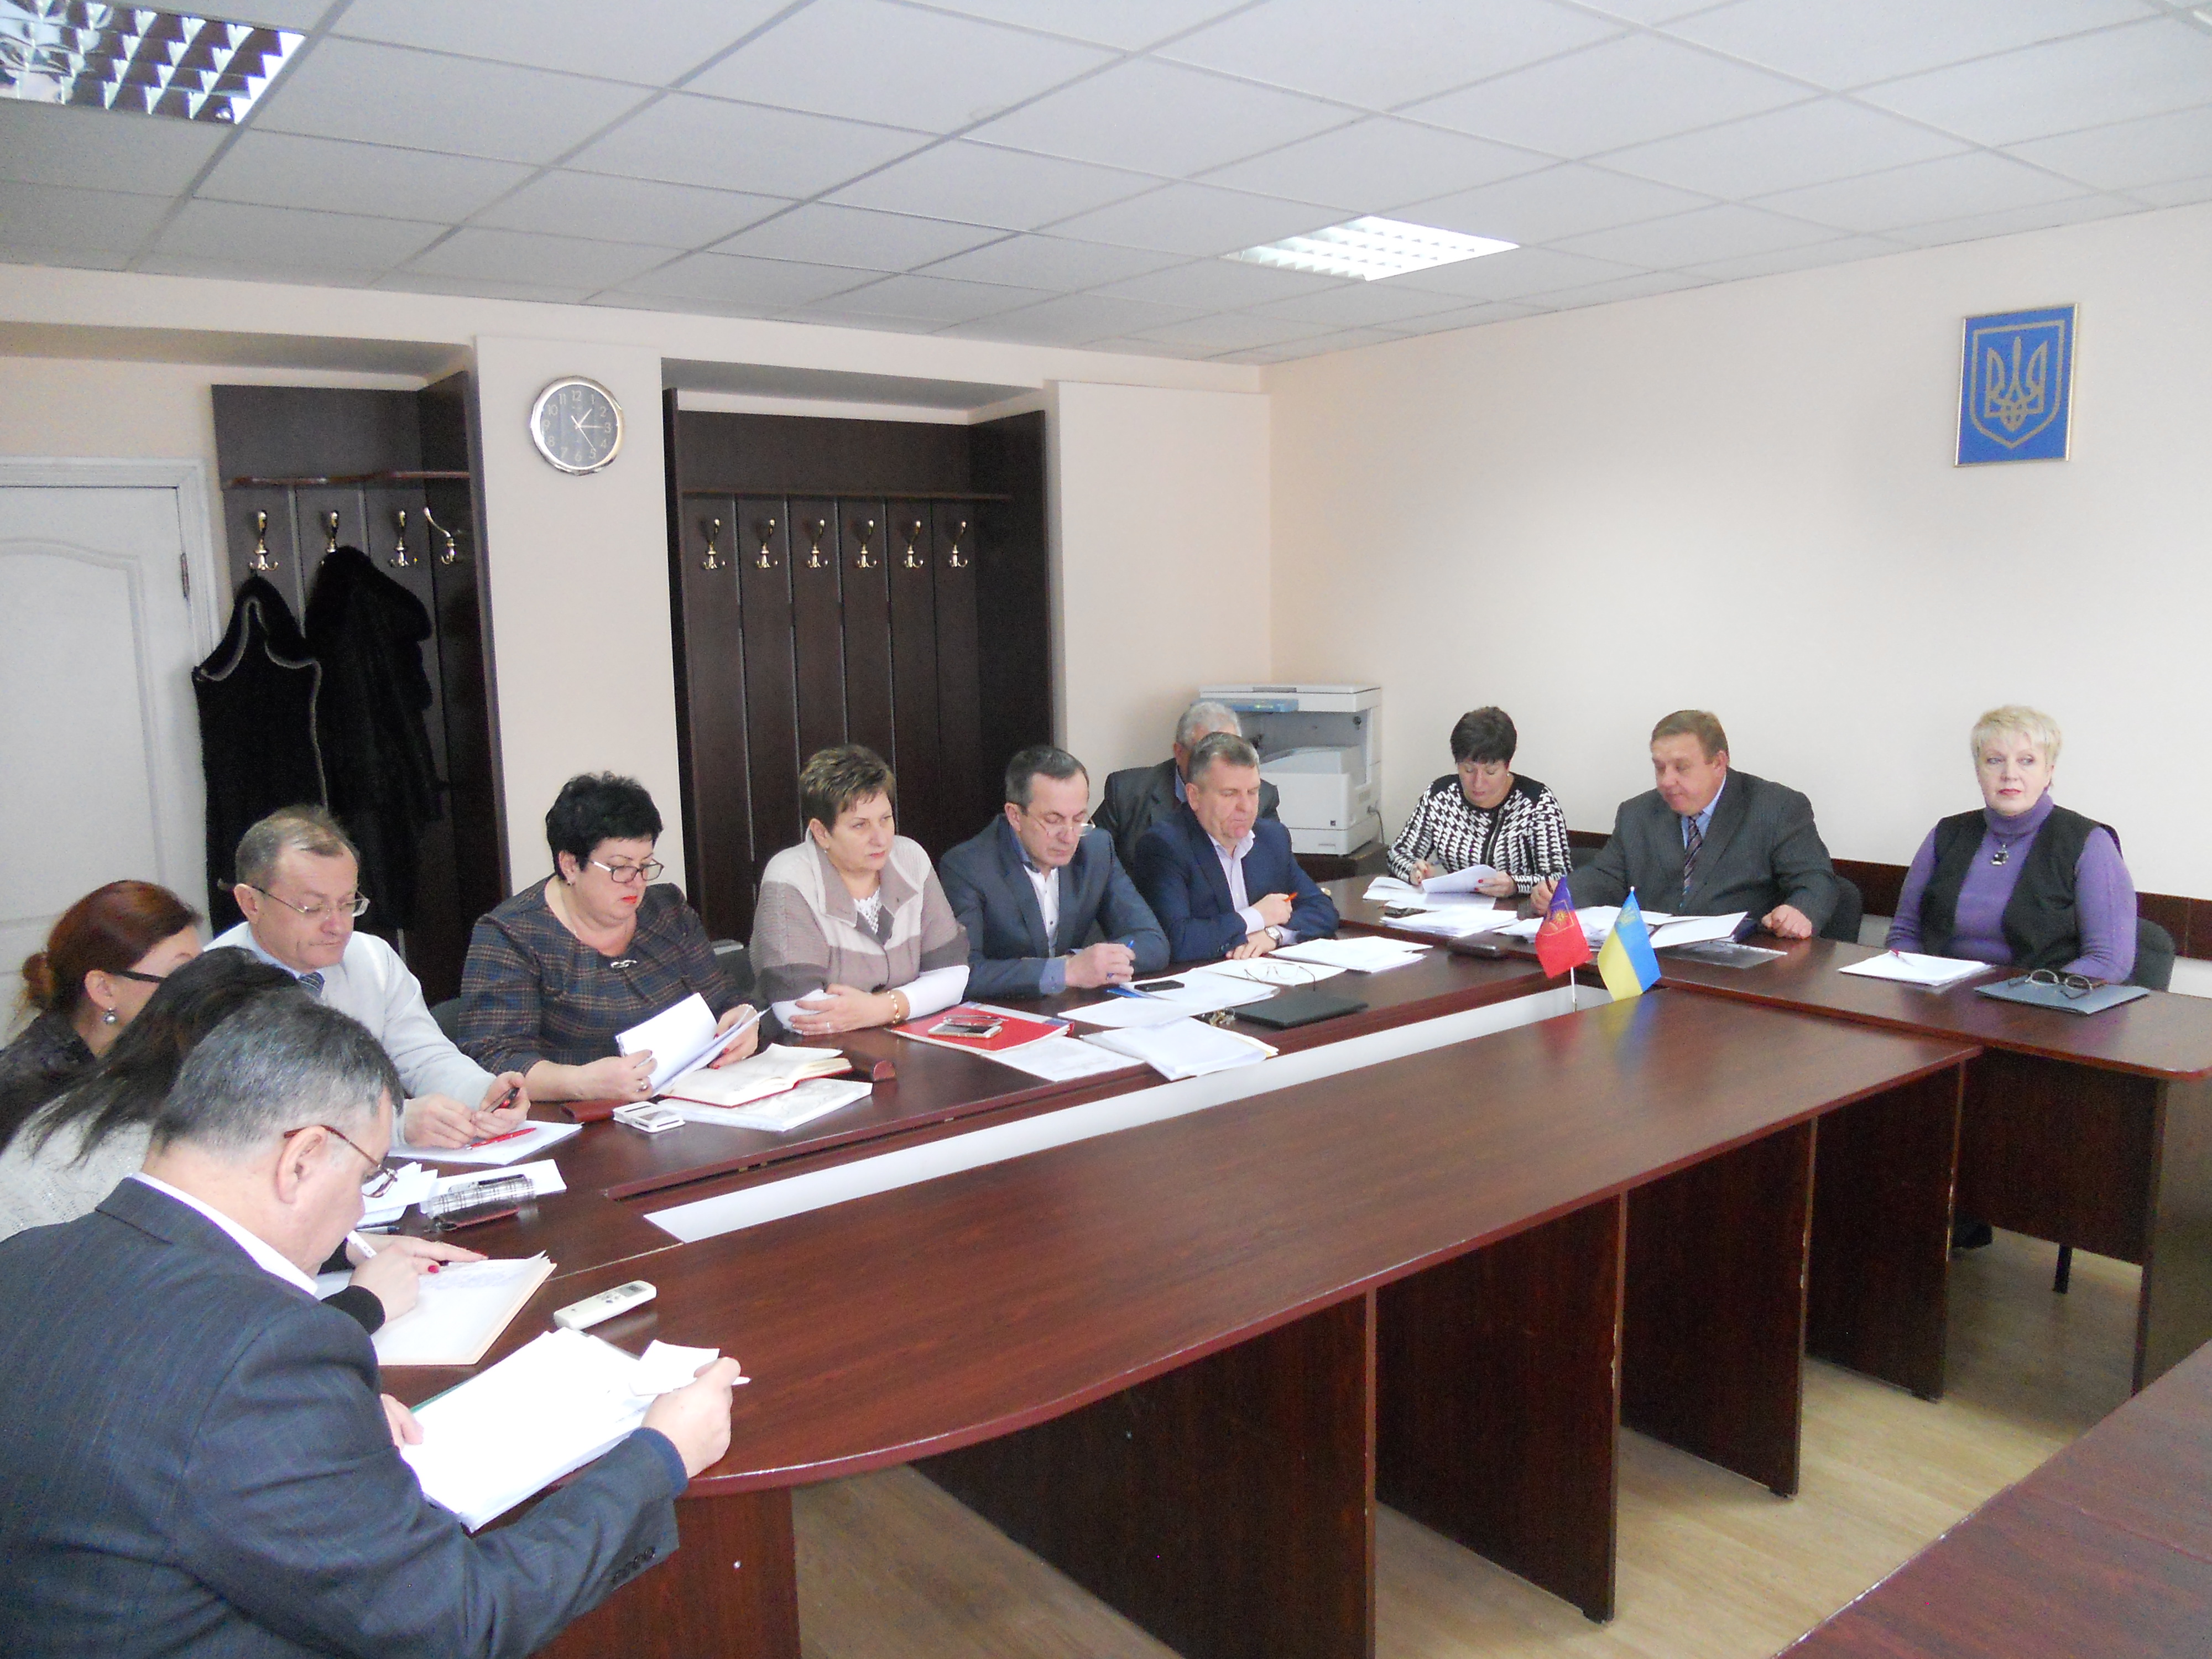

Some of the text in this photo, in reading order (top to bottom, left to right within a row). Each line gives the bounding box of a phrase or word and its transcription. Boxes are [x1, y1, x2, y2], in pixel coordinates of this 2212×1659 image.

[559, 393, 566, 405] 11
[571, 390, 582, 401] 12
[547, 404, 558, 416] 10
[599, 406, 606, 418] 2
[604, 422, 611, 433] 3
[547, 436, 555, 447] 8
[601, 439, 607, 448] 4
[560, 447, 568, 459] 7
[575, 449, 582, 462] 6
